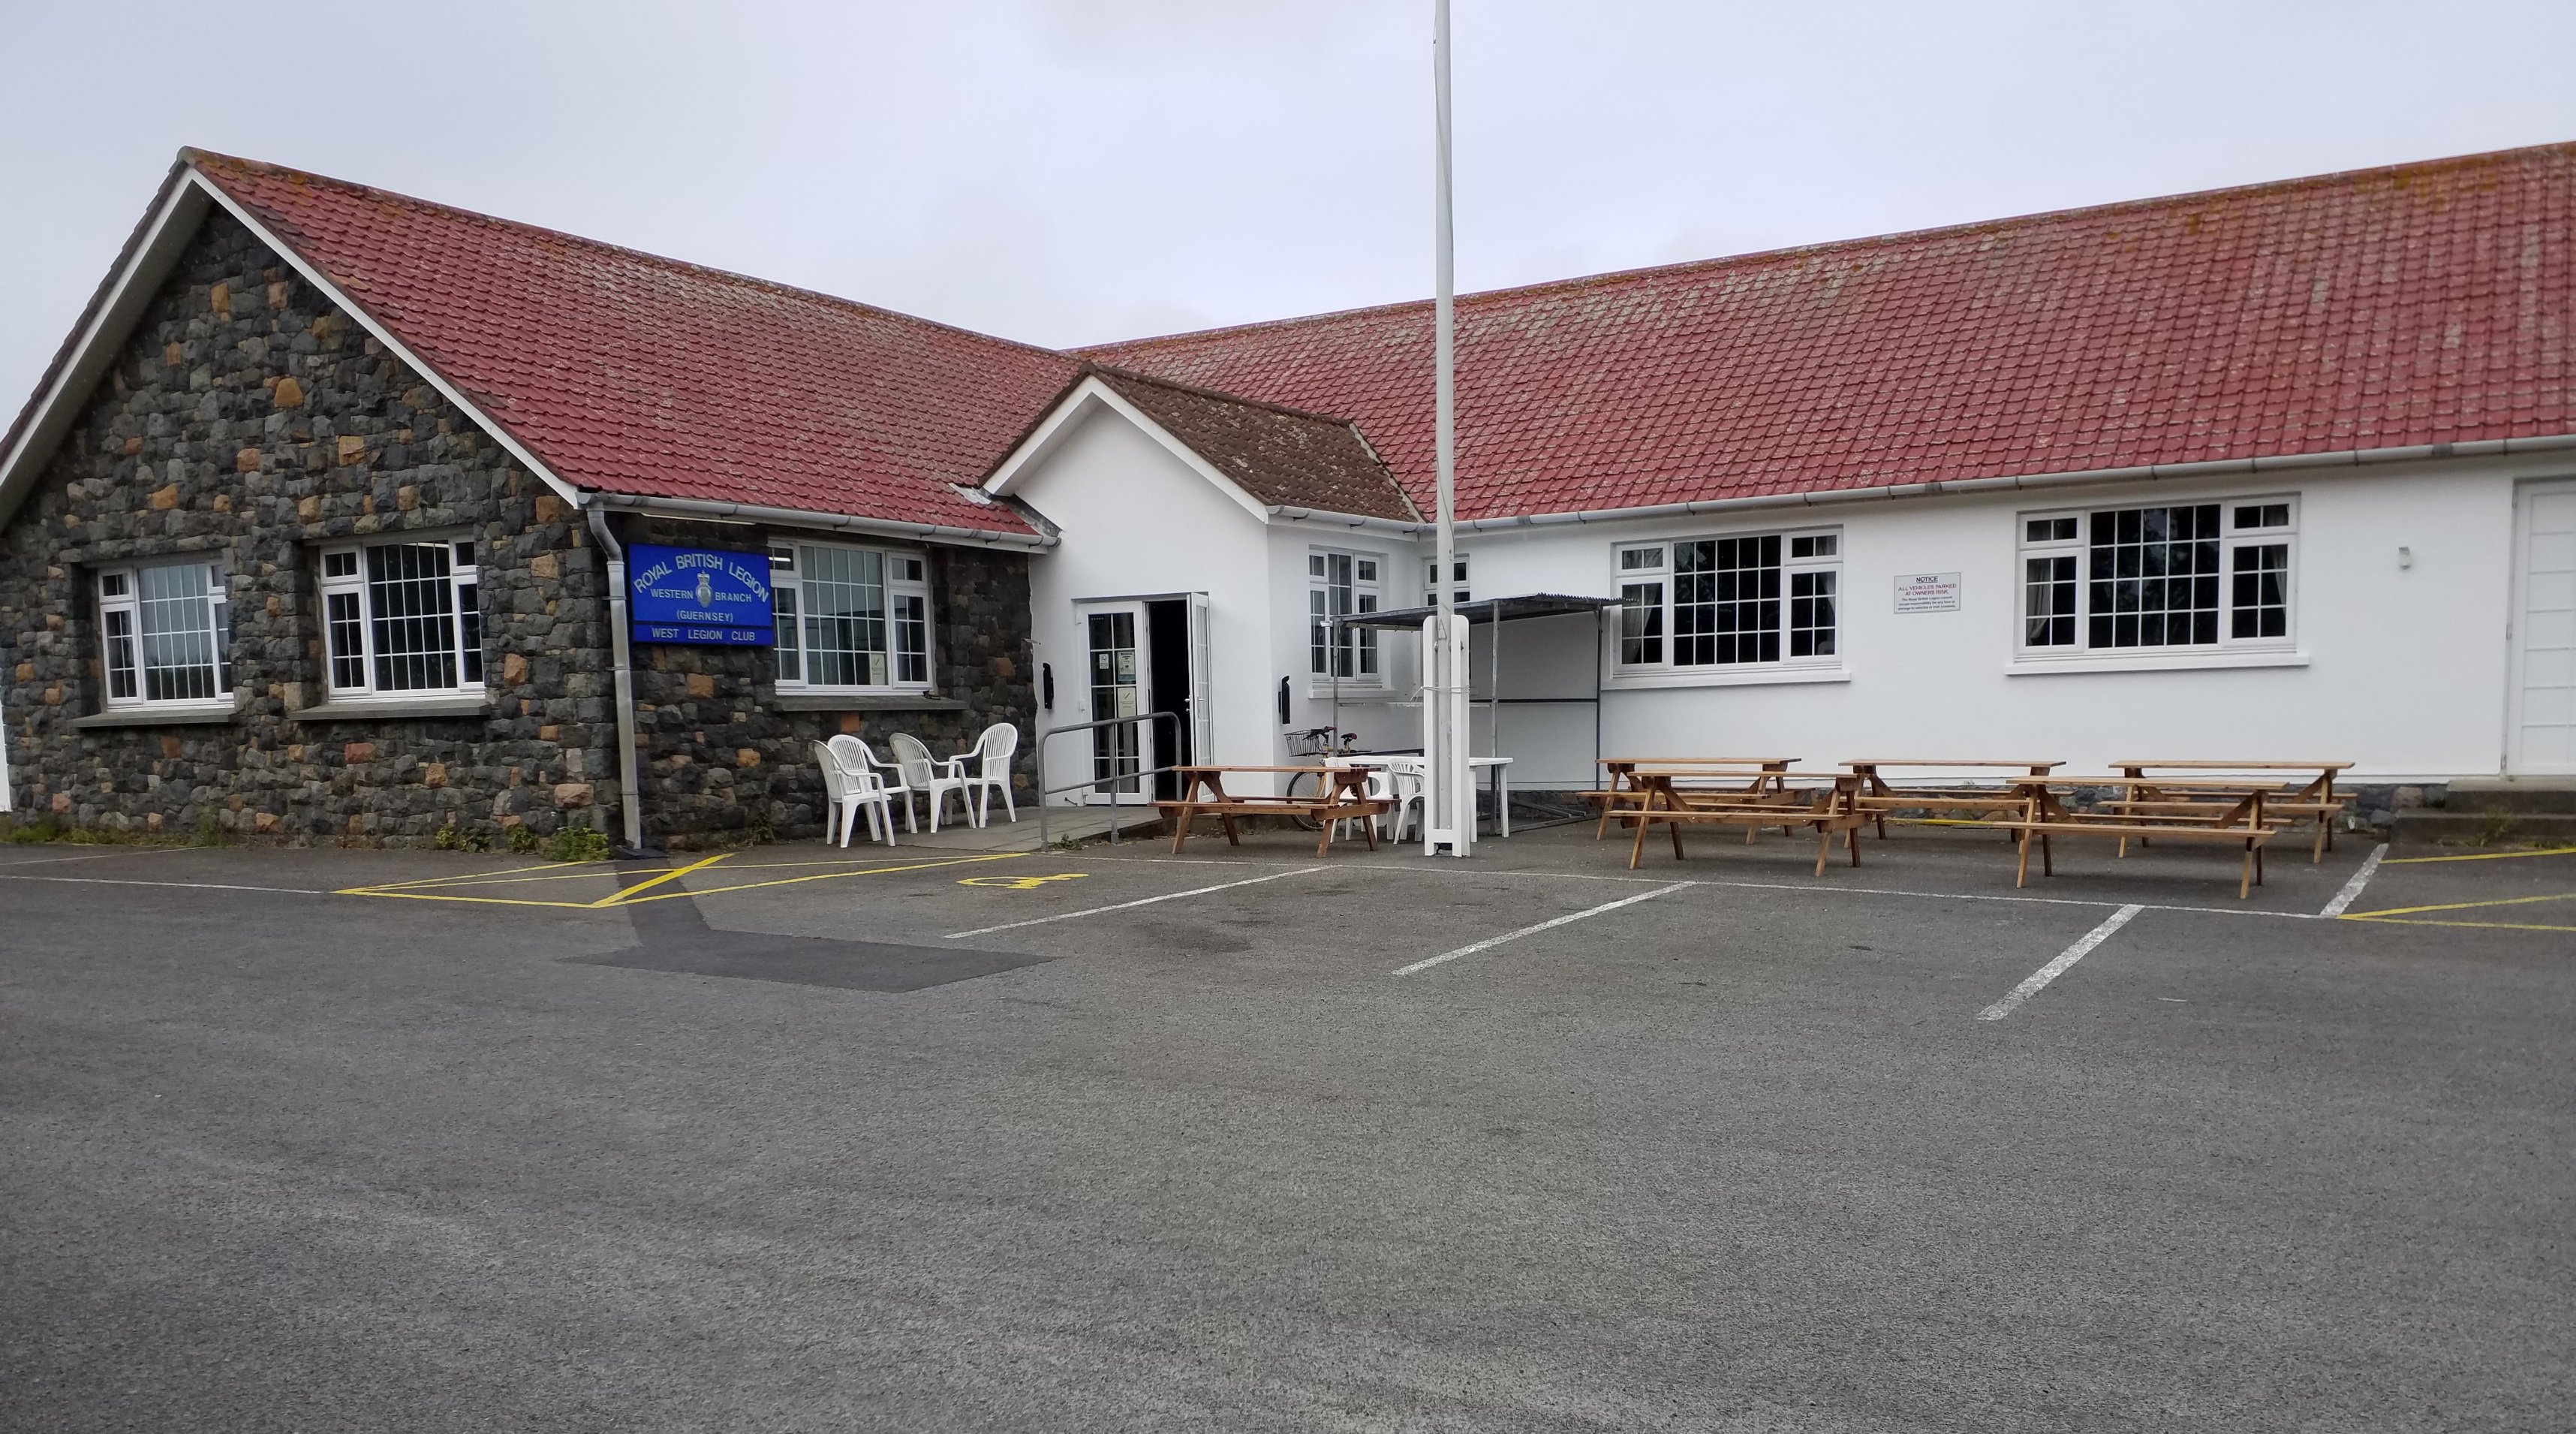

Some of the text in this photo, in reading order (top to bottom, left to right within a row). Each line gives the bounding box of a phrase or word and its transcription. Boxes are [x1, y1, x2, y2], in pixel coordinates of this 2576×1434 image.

[633, 553, 769, 603] ROYAL BRITISH LEGION
[650, 589, 752, 602] WESTERN BRANCH
[677, 610, 733, 623] (GUERNSEY)
[652, 628, 755, 641] WEST LEGION CLUB
